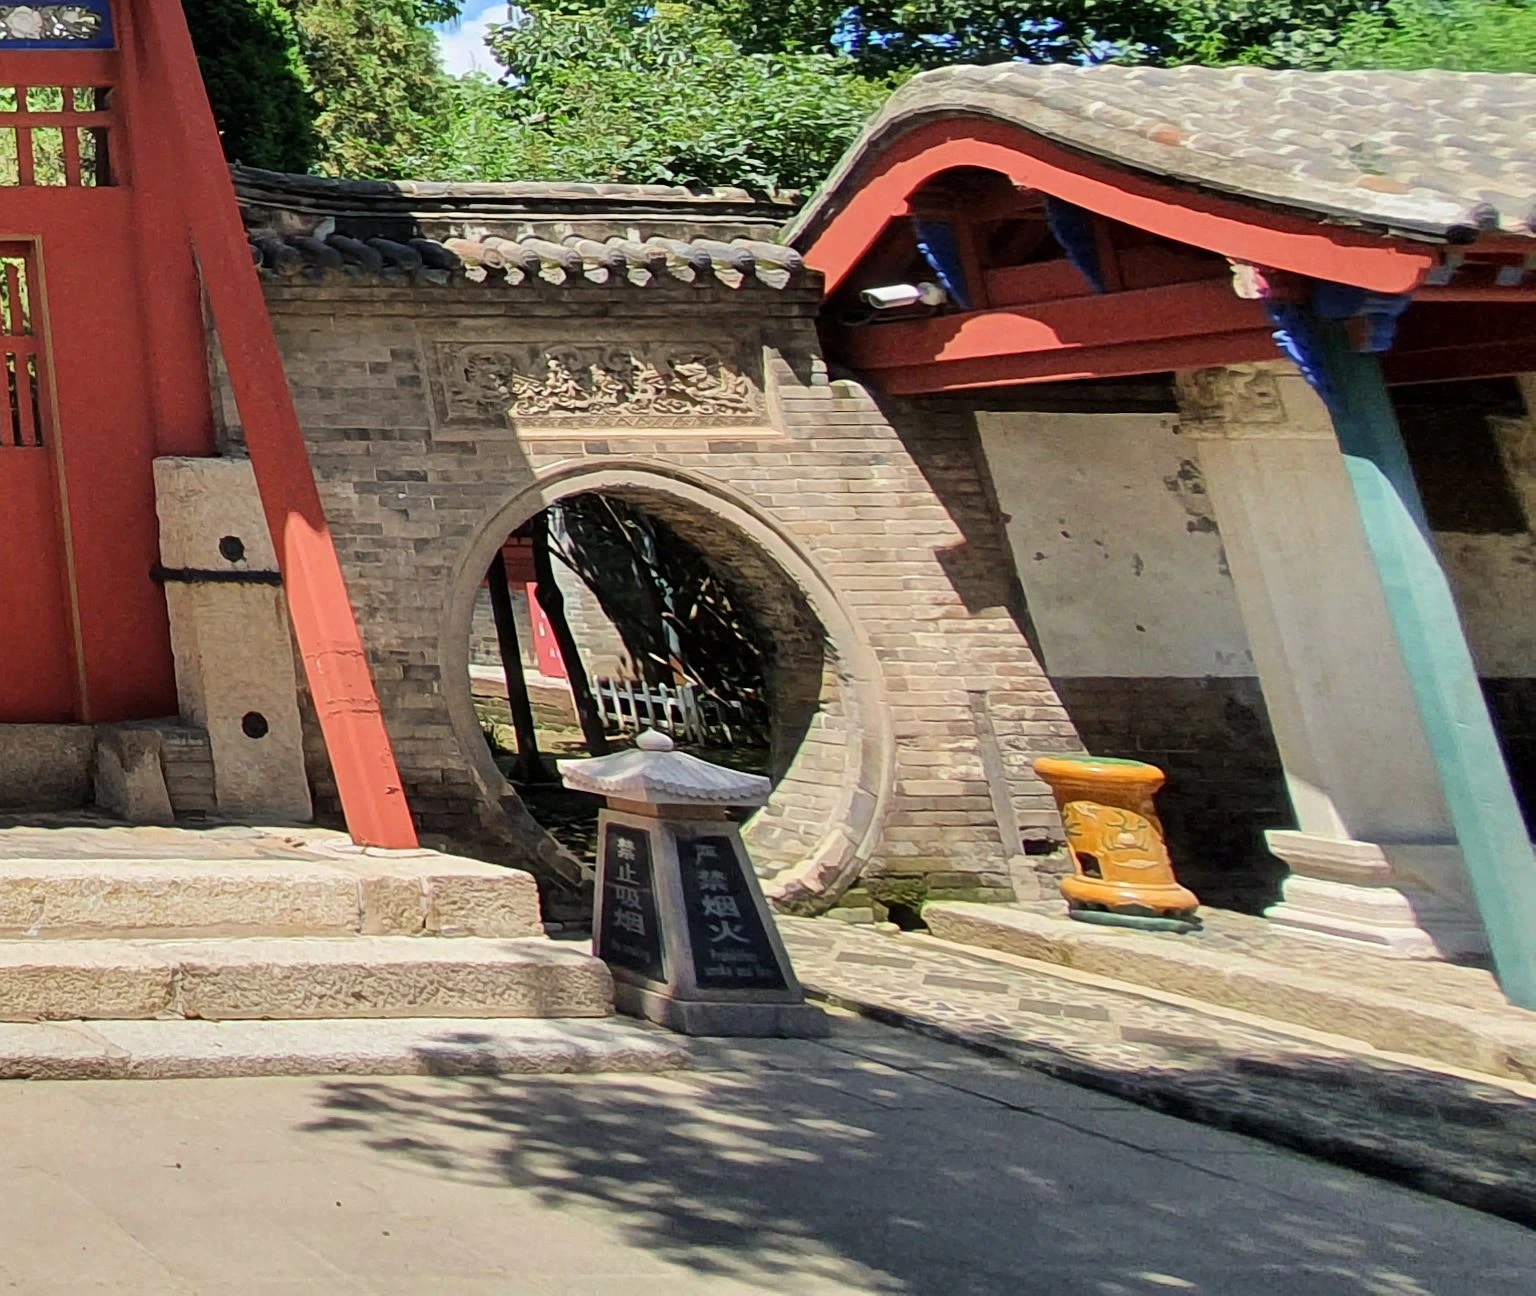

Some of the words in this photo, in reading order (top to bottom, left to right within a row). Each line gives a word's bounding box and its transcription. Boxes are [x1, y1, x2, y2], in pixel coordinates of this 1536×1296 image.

[612, 836, 646, 936] 禁止吸烟
[695, 844, 750, 943] 严禁烟火
